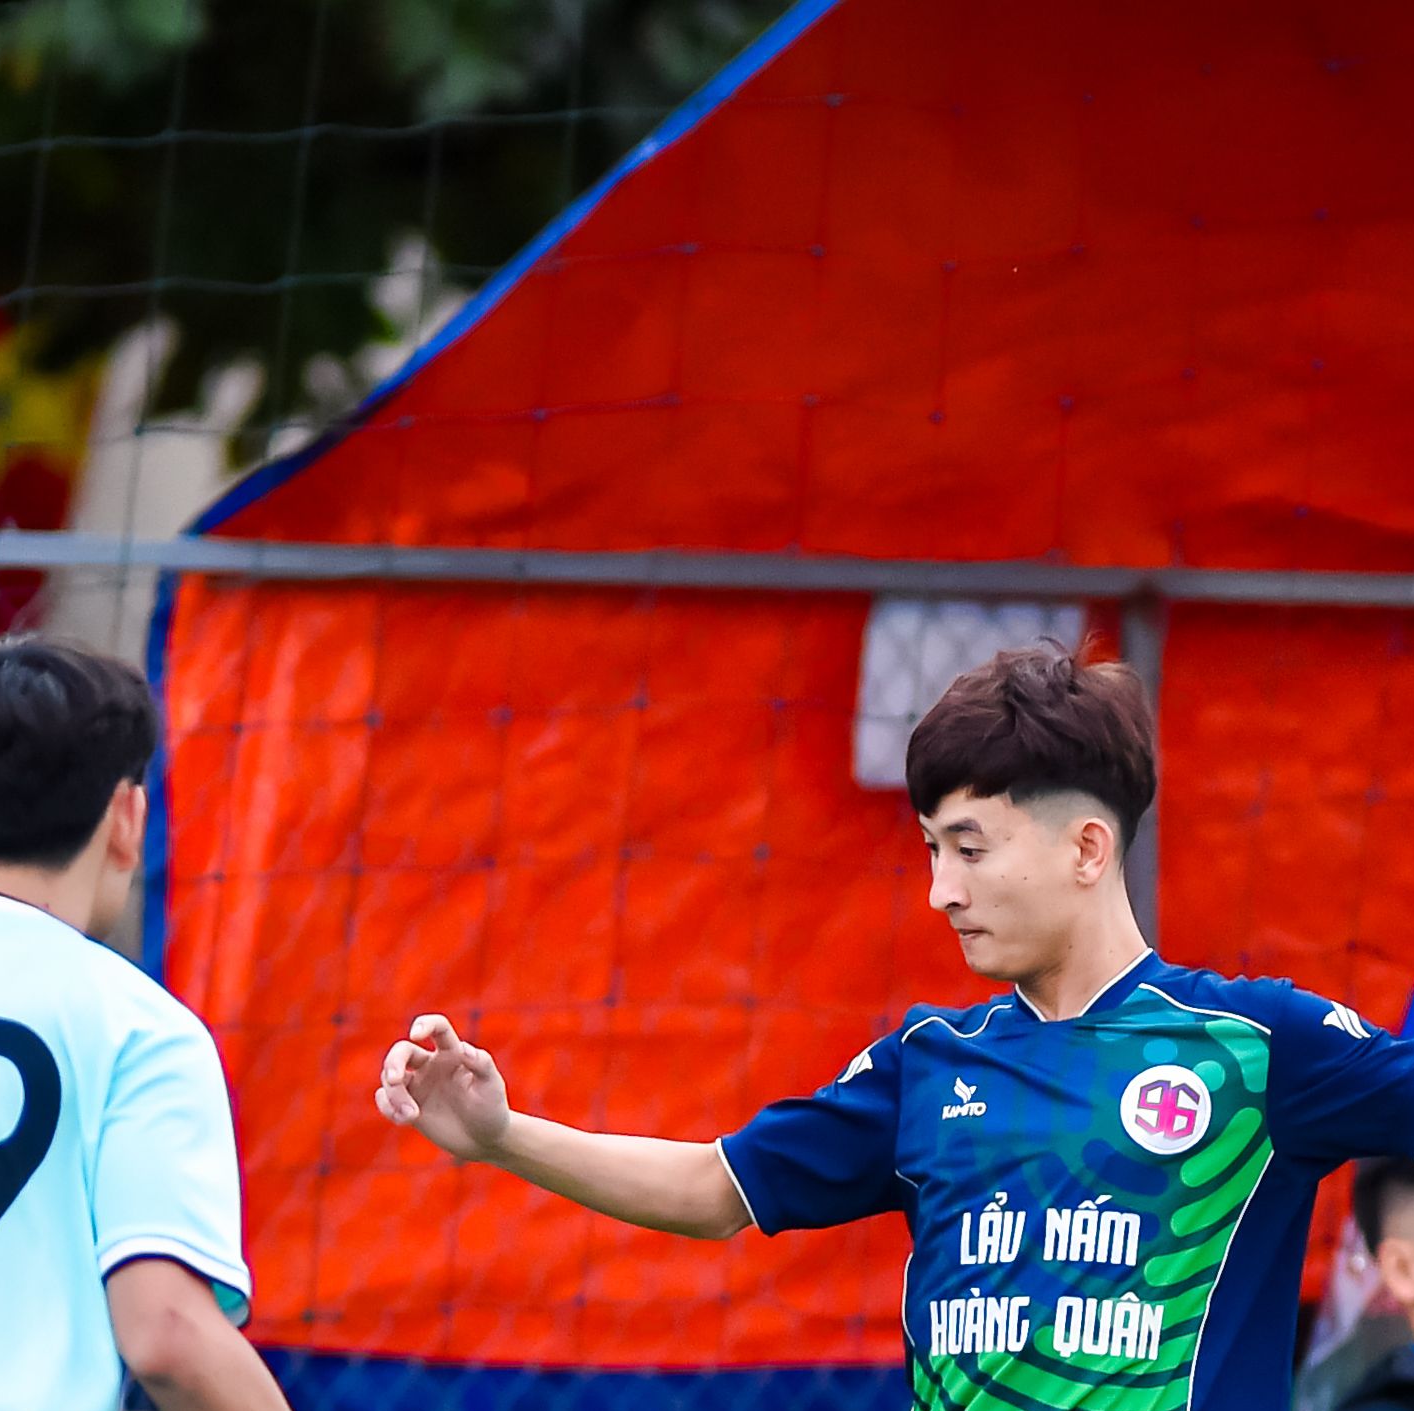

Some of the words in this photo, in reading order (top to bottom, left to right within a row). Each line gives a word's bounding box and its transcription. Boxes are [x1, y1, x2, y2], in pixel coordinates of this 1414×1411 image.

[1043, 1195, 1141, 1266] NẤM
[930, 1288, 1030, 1357] HOÀNG
[1053, 1292, 1164, 1361] QUÂN
